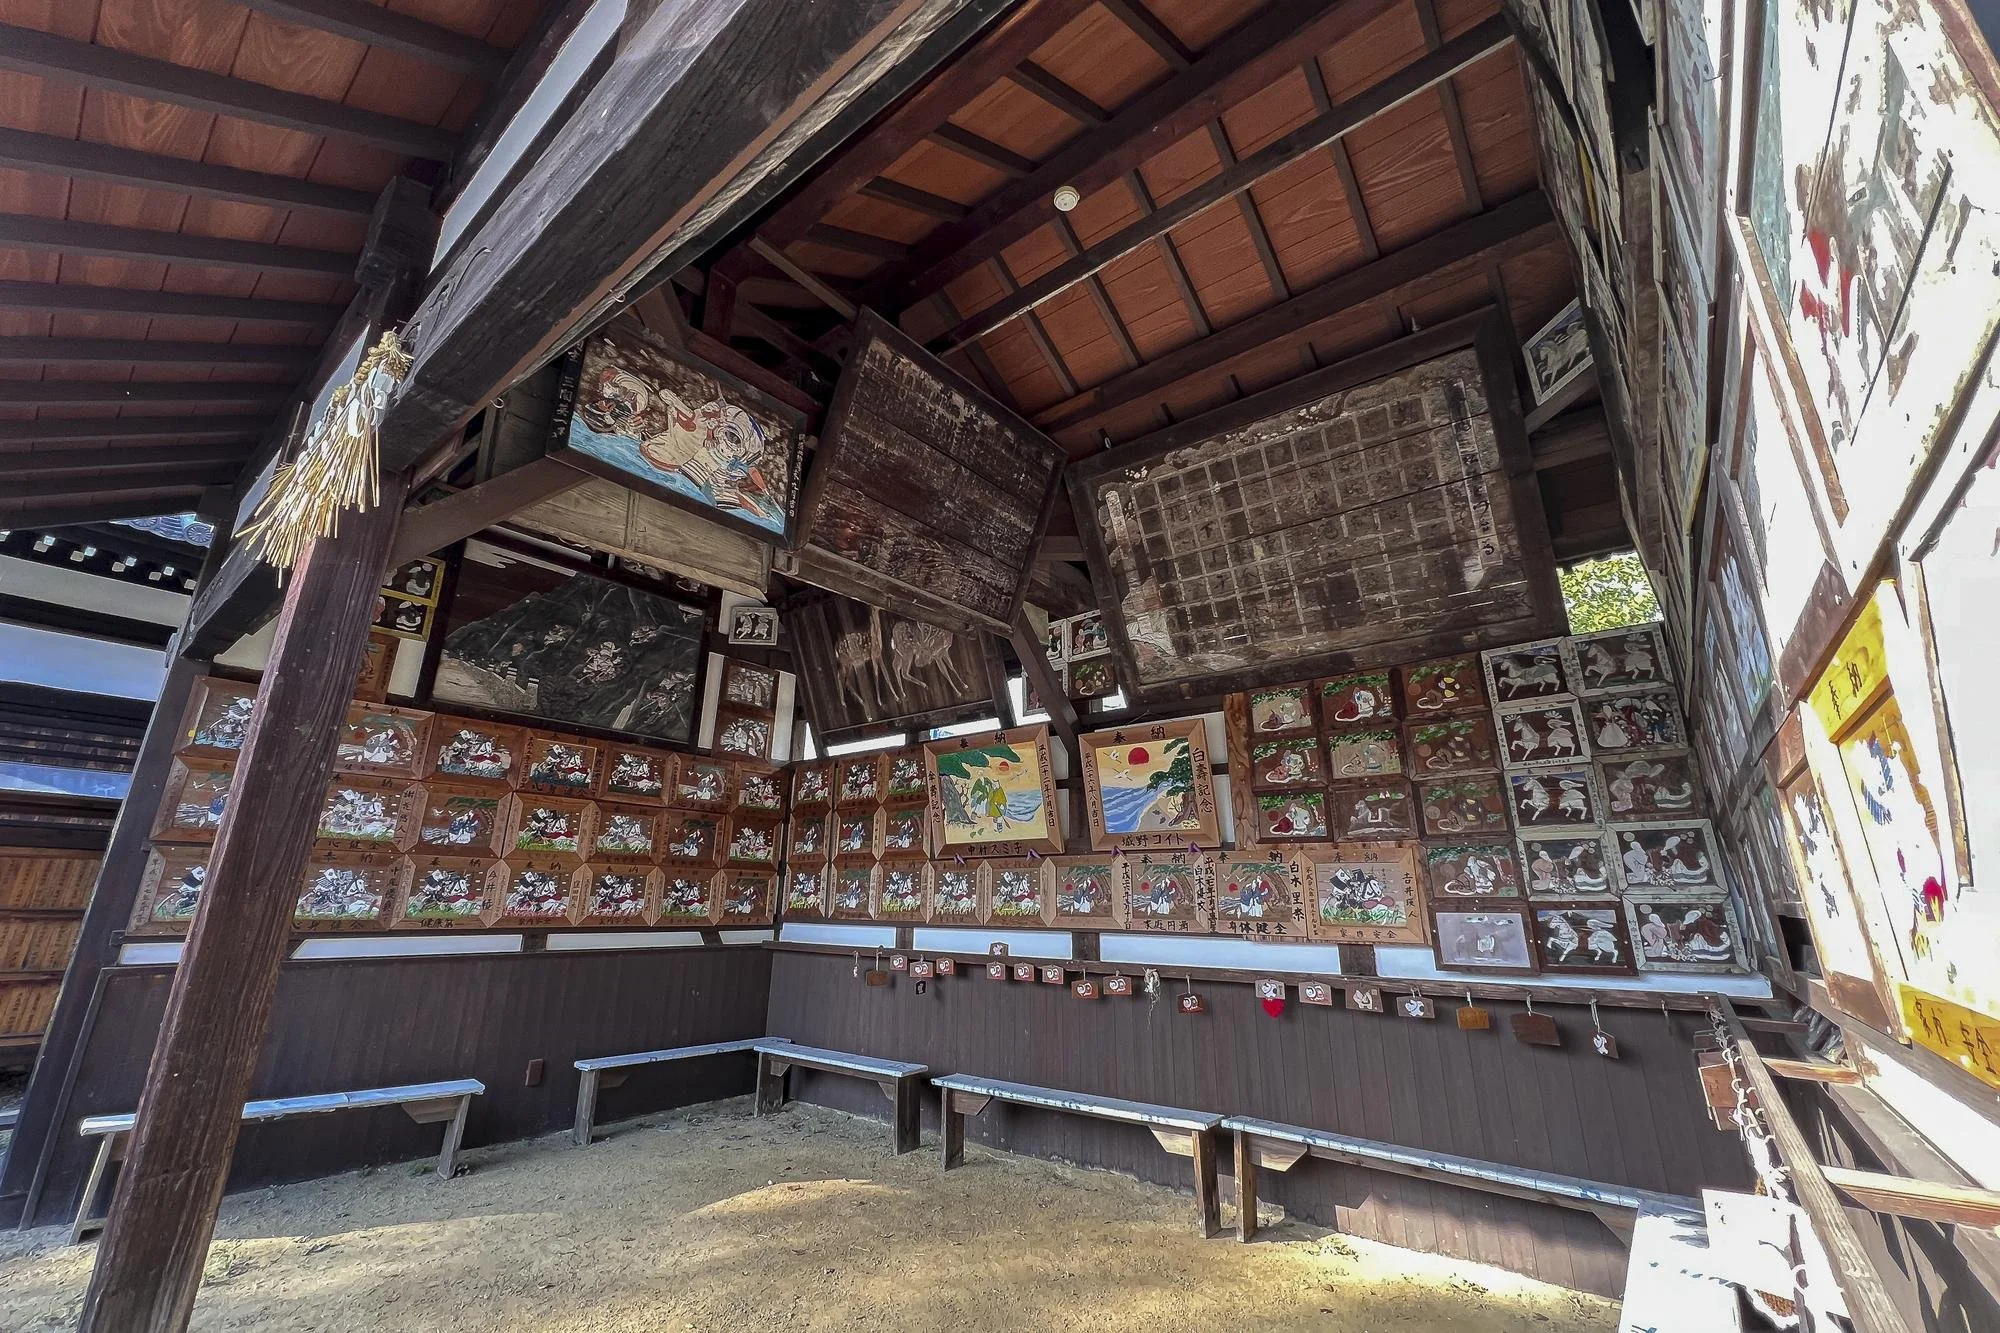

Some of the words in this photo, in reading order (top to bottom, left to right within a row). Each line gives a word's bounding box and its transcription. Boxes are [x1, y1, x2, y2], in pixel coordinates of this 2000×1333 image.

[959, 731, 1006, 749] 奉納
[1112, 725, 1166, 744] 奉納
[1121, 834, 1185, 848] 城野コイト
[967, 842, 1023, 855] 中村スミ子
[1140, 852, 1186, 864] 奉納
[1217, 849, 1283, 864] 奉納
[1334, 852, 1379, 864] 奉納
[1289, 860, 1305, 922] 白木里奈
[1227, 921, 1288, 935] 身体健全
[1339, 928, 1398, 939] 家内安全
